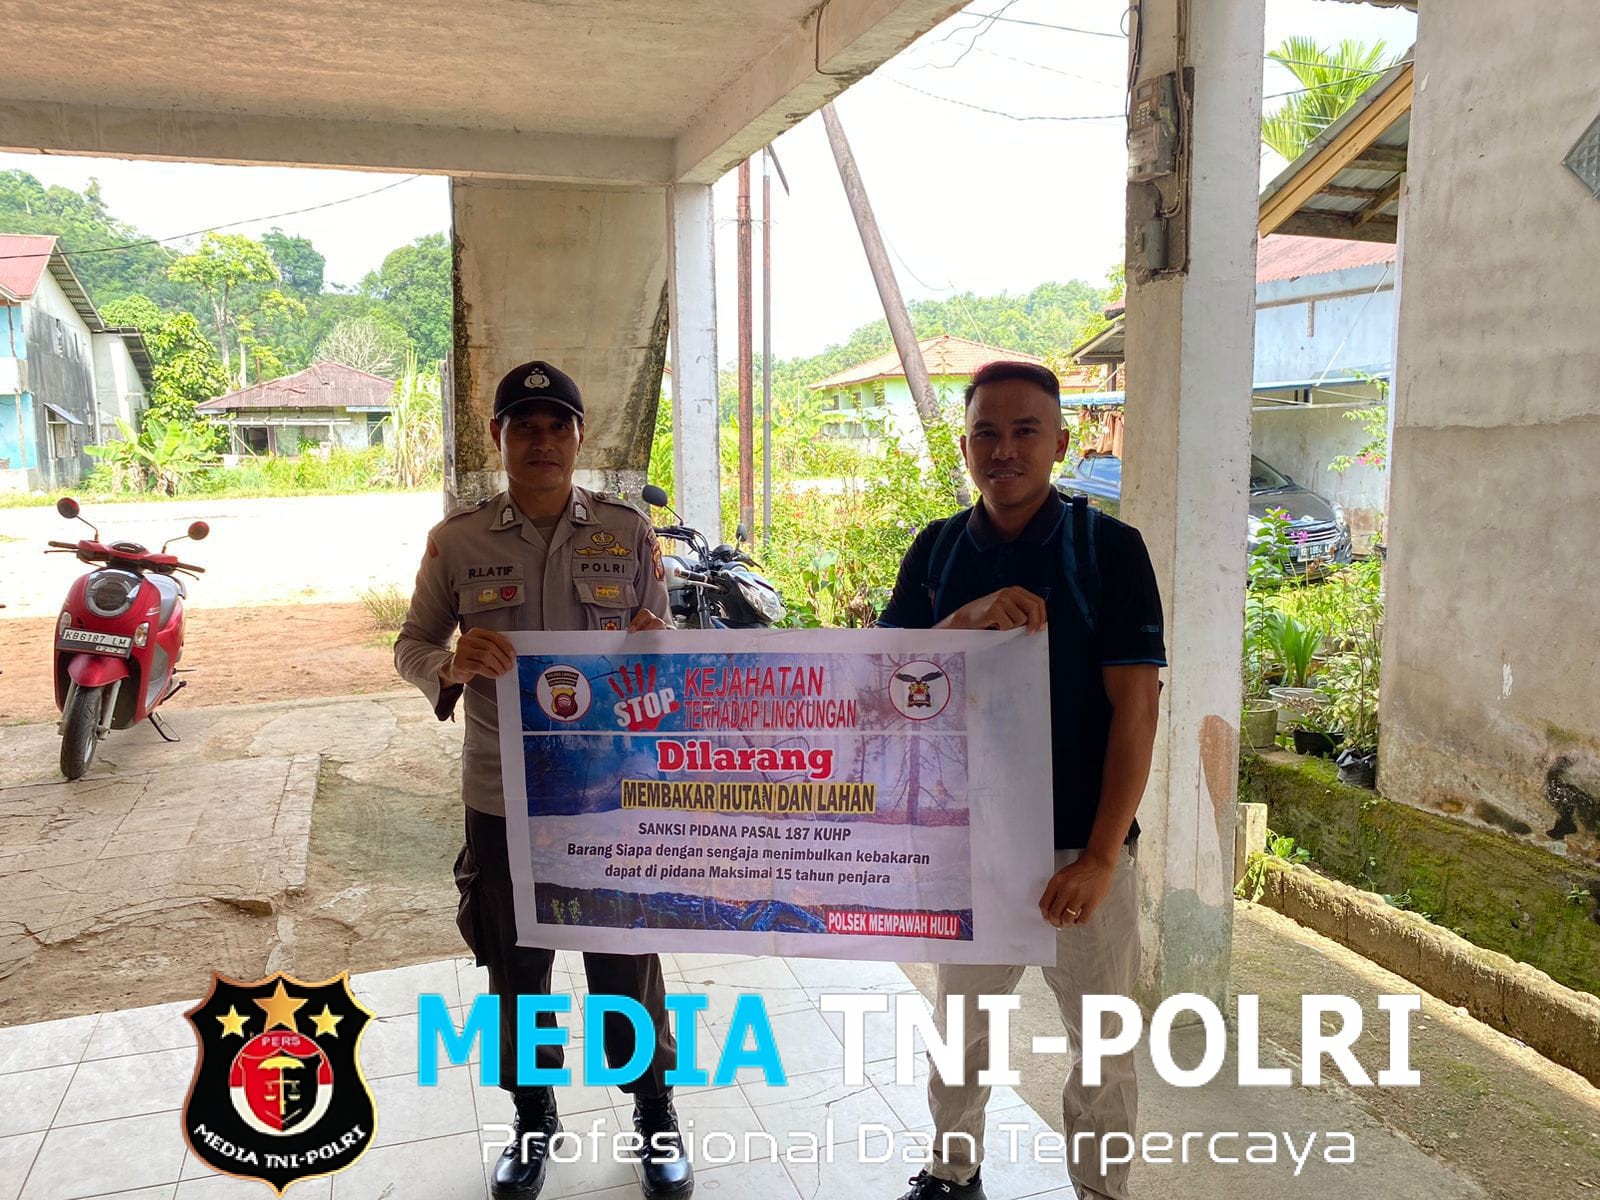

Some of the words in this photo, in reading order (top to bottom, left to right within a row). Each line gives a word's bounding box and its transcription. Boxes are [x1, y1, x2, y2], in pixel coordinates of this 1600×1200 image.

[468, 566, 514, 579] R.LATIF
[581, 563, 625, 574] POLRI
[684, 666, 824, 698] KEJAHATAN
[613, 687, 676, 728] STOP
[684, 700, 758, 729] TERHADAP
[762, 700, 857, 729] LINGKUNGAN
[657, 740, 834, 778] Dilarang
[623, 781, 715, 808] MEMBAKAR
[719, 783, 773, 810] HUTAN
[778, 784, 815, 811] DAN
[816, 785, 876, 812] LAHAN
[638, 822, 686, 836] SANKSI
[689, 824, 737, 838] PIDANA
[741, 826, 782, 839] PASAL
[785, 827, 810, 840] 187
[813, 828, 851, 841] KUHP
[567, 843, 613, 859] Barang
[616, 843, 652, 859] Siapa
[655, 844, 703, 860] dengan
[706, 846, 759, 862] sengaja
[762, 847, 852, 862] menimbulkan
[856, 850, 930, 865] kebakaran
[605, 865, 642, 879] dapat
[645, 865, 657, 878] di
[660, 865, 706, 880] pidana
[709, 866, 773, 880] Maksimal
[775, 868, 792, 880] 15
[795, 869, 834, 882] tahun
[837, 871, 891, 885] penjara
[828, 912, 867, 931] POLSEK
[869, 913, 928, 934] MEMPAWAH
[930, 915, 958, 936] HULU
